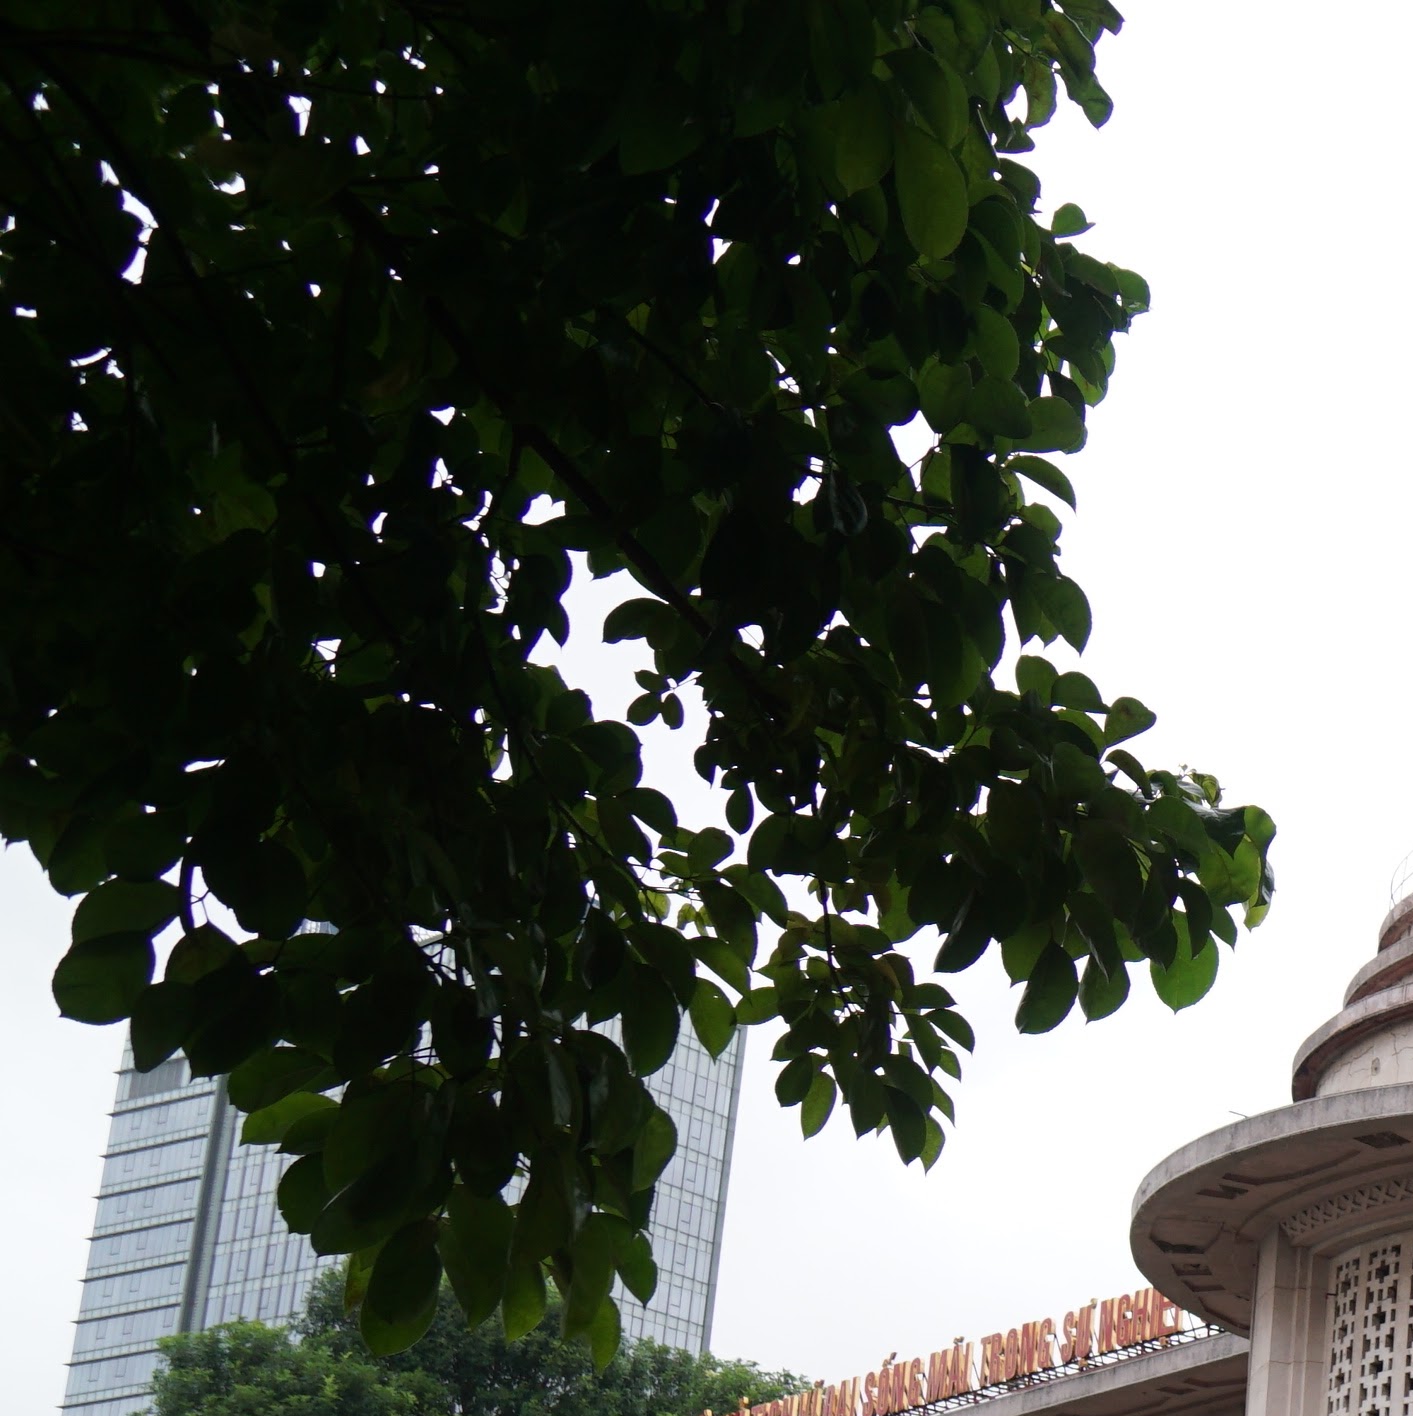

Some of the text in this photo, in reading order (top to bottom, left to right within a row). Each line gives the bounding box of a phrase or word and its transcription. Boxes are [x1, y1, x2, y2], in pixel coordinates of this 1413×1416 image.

[926, 1336, 975, 1403] MÃI
[980, 1318, 1056, 1388] TRONG
[1061, 1298, 1098, 1370] SỰ
